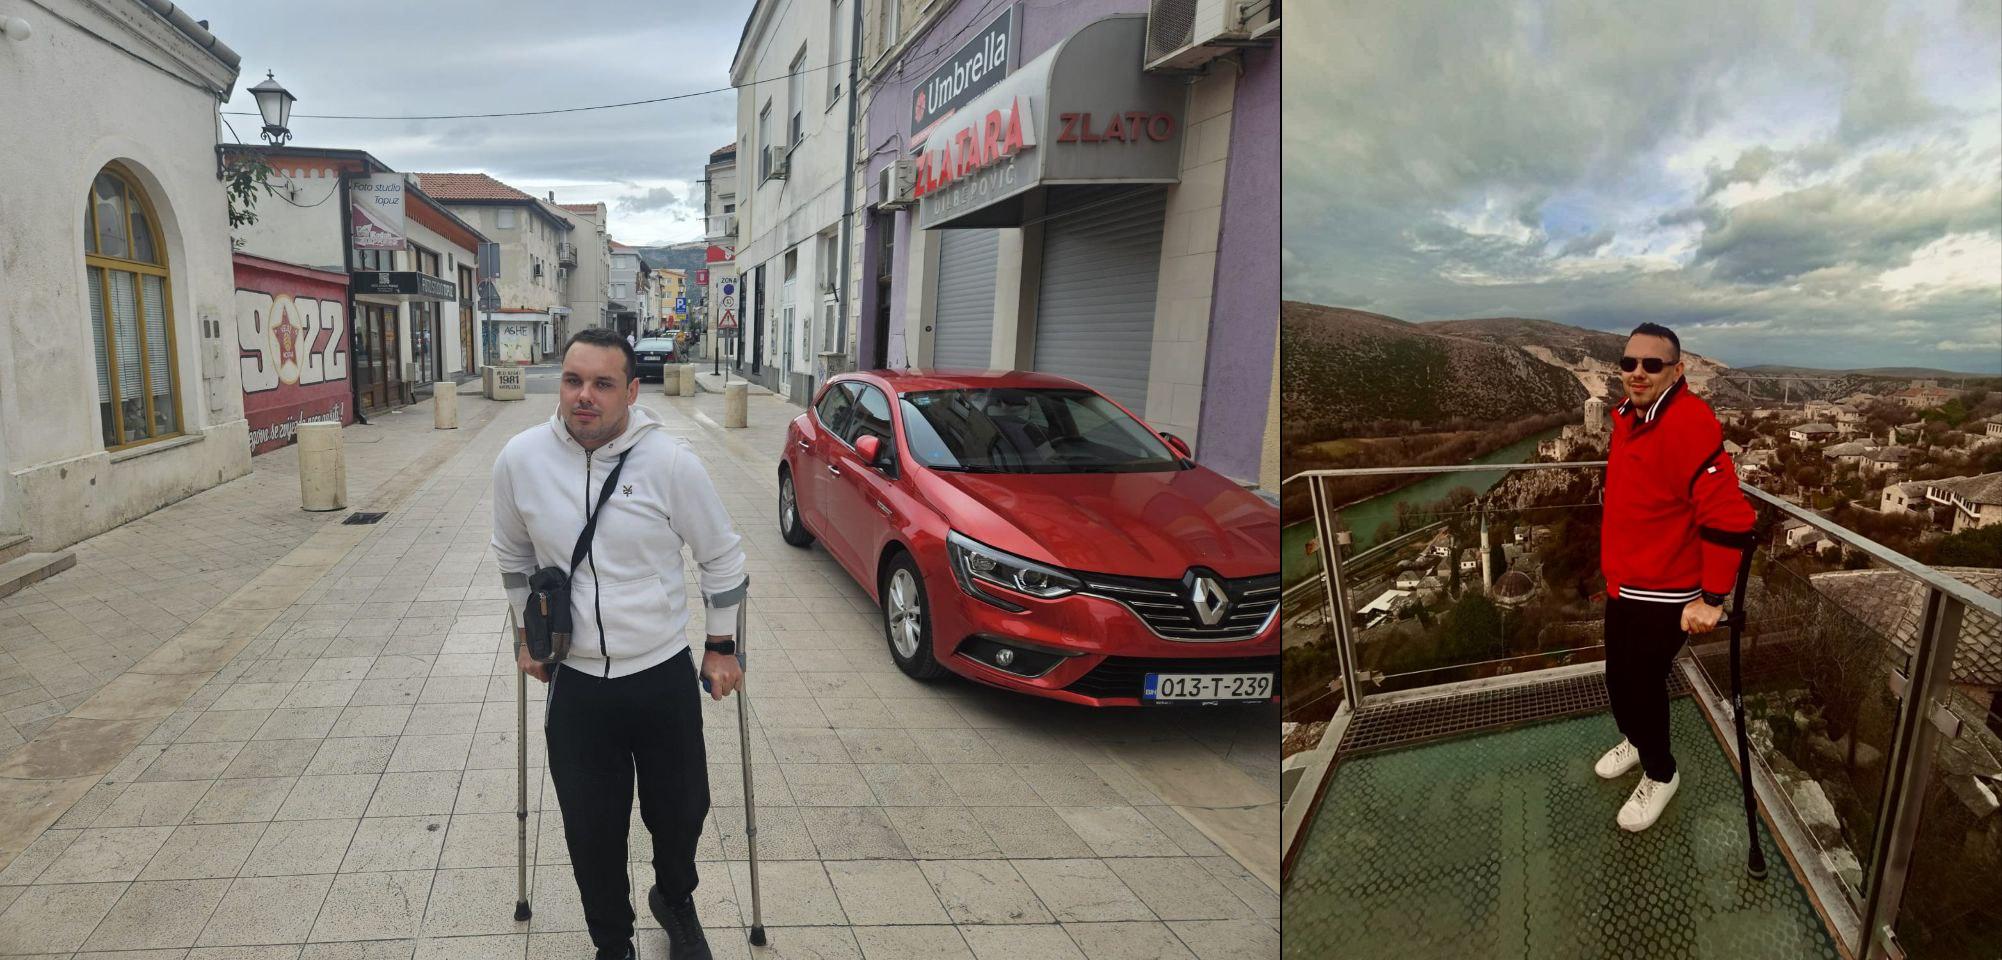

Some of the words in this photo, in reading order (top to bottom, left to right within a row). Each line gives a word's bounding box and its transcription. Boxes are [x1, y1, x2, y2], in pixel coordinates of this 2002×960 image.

[928, 31, 1006, 114] Umbrella
[1057, 111, 1175, 143] ZLATO
[914, 96, 1023, 199] ZLATARA
[353, 183, 373, 191] Foto
[375, 183, 400, 191] studio
[375, 196, 399, 206] Topuz
[499, 375, 520, 384] 1981
[1161, 677, 1270, 697] 013-T-239
